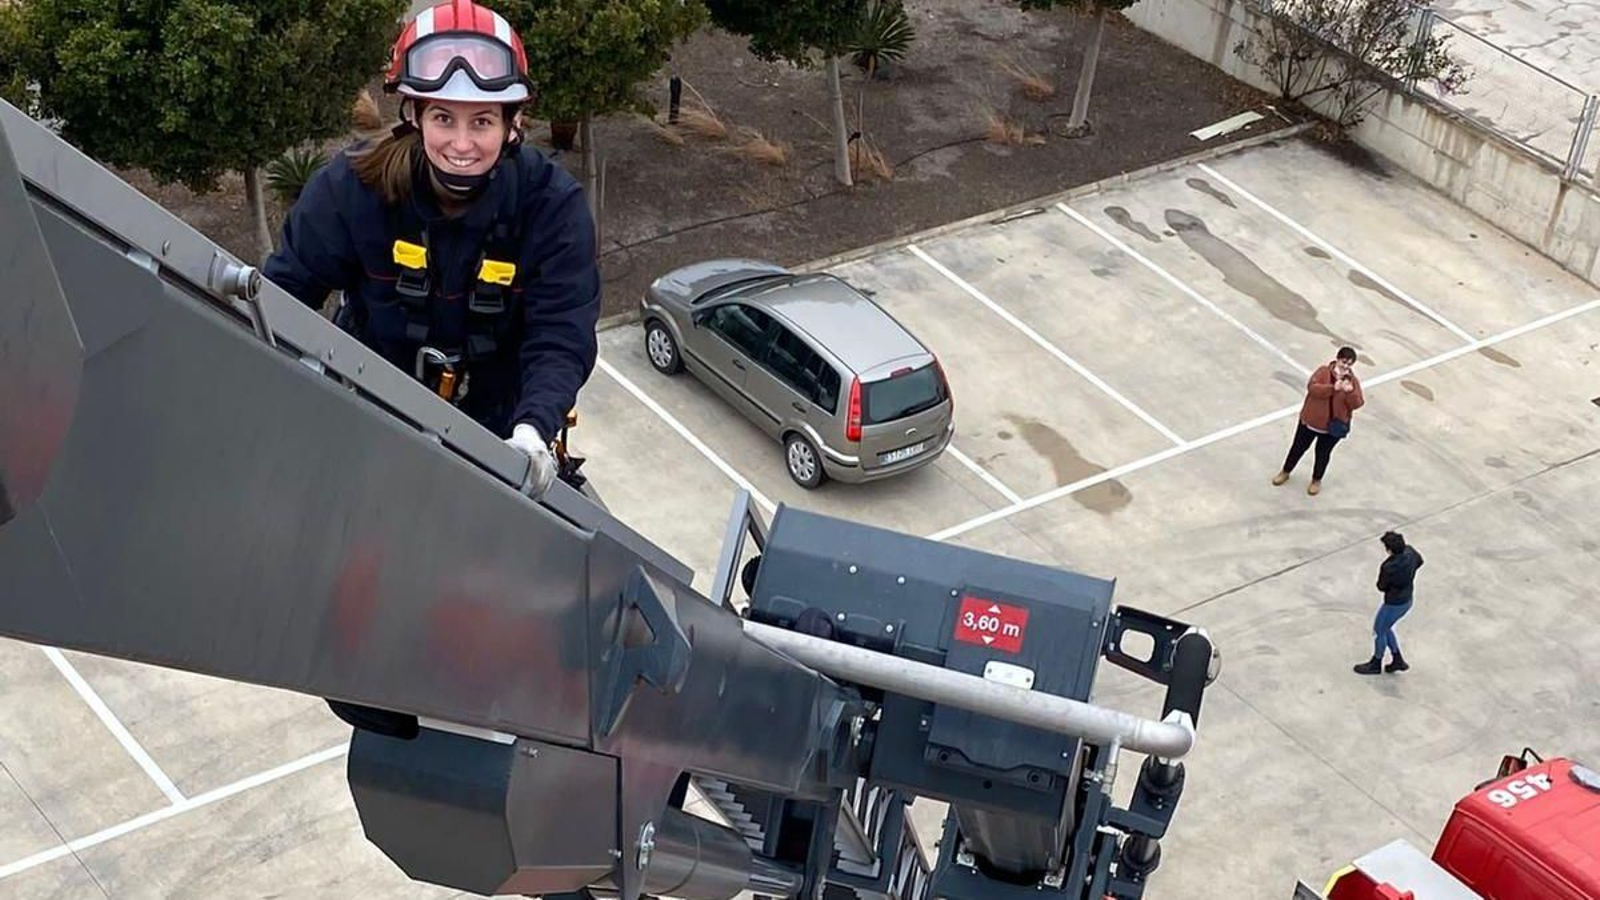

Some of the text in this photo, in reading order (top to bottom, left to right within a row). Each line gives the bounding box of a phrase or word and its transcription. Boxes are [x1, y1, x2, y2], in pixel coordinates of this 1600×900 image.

[963, 612, 1020, 637] 3,60 m
[1487, 773, 1551, 808] 456
